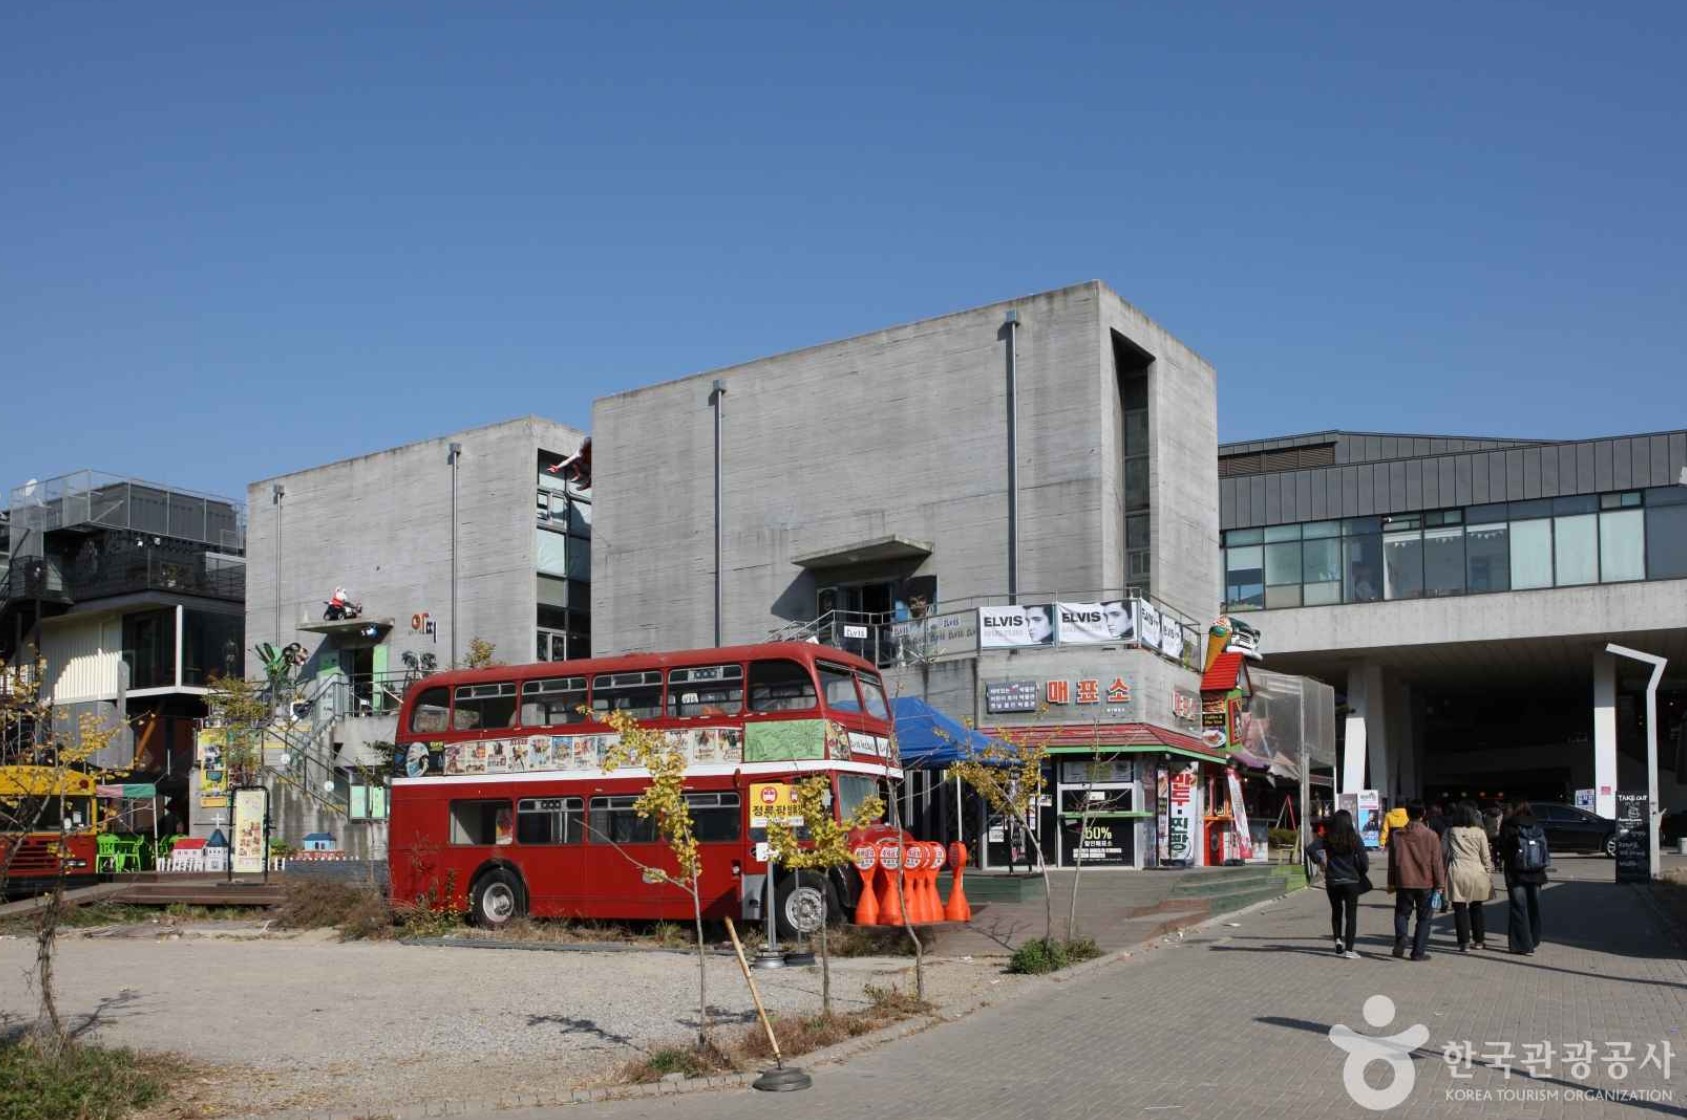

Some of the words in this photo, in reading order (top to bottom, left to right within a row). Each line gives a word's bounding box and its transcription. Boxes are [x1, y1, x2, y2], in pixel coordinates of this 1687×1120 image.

[984, 615, 1023, 627] ELVIS
[1062, 611, 1101, 624] ELVIS
[1046, 677, 1130, 704] 매표소
[1617, 794, 1635, 802] TAKE
